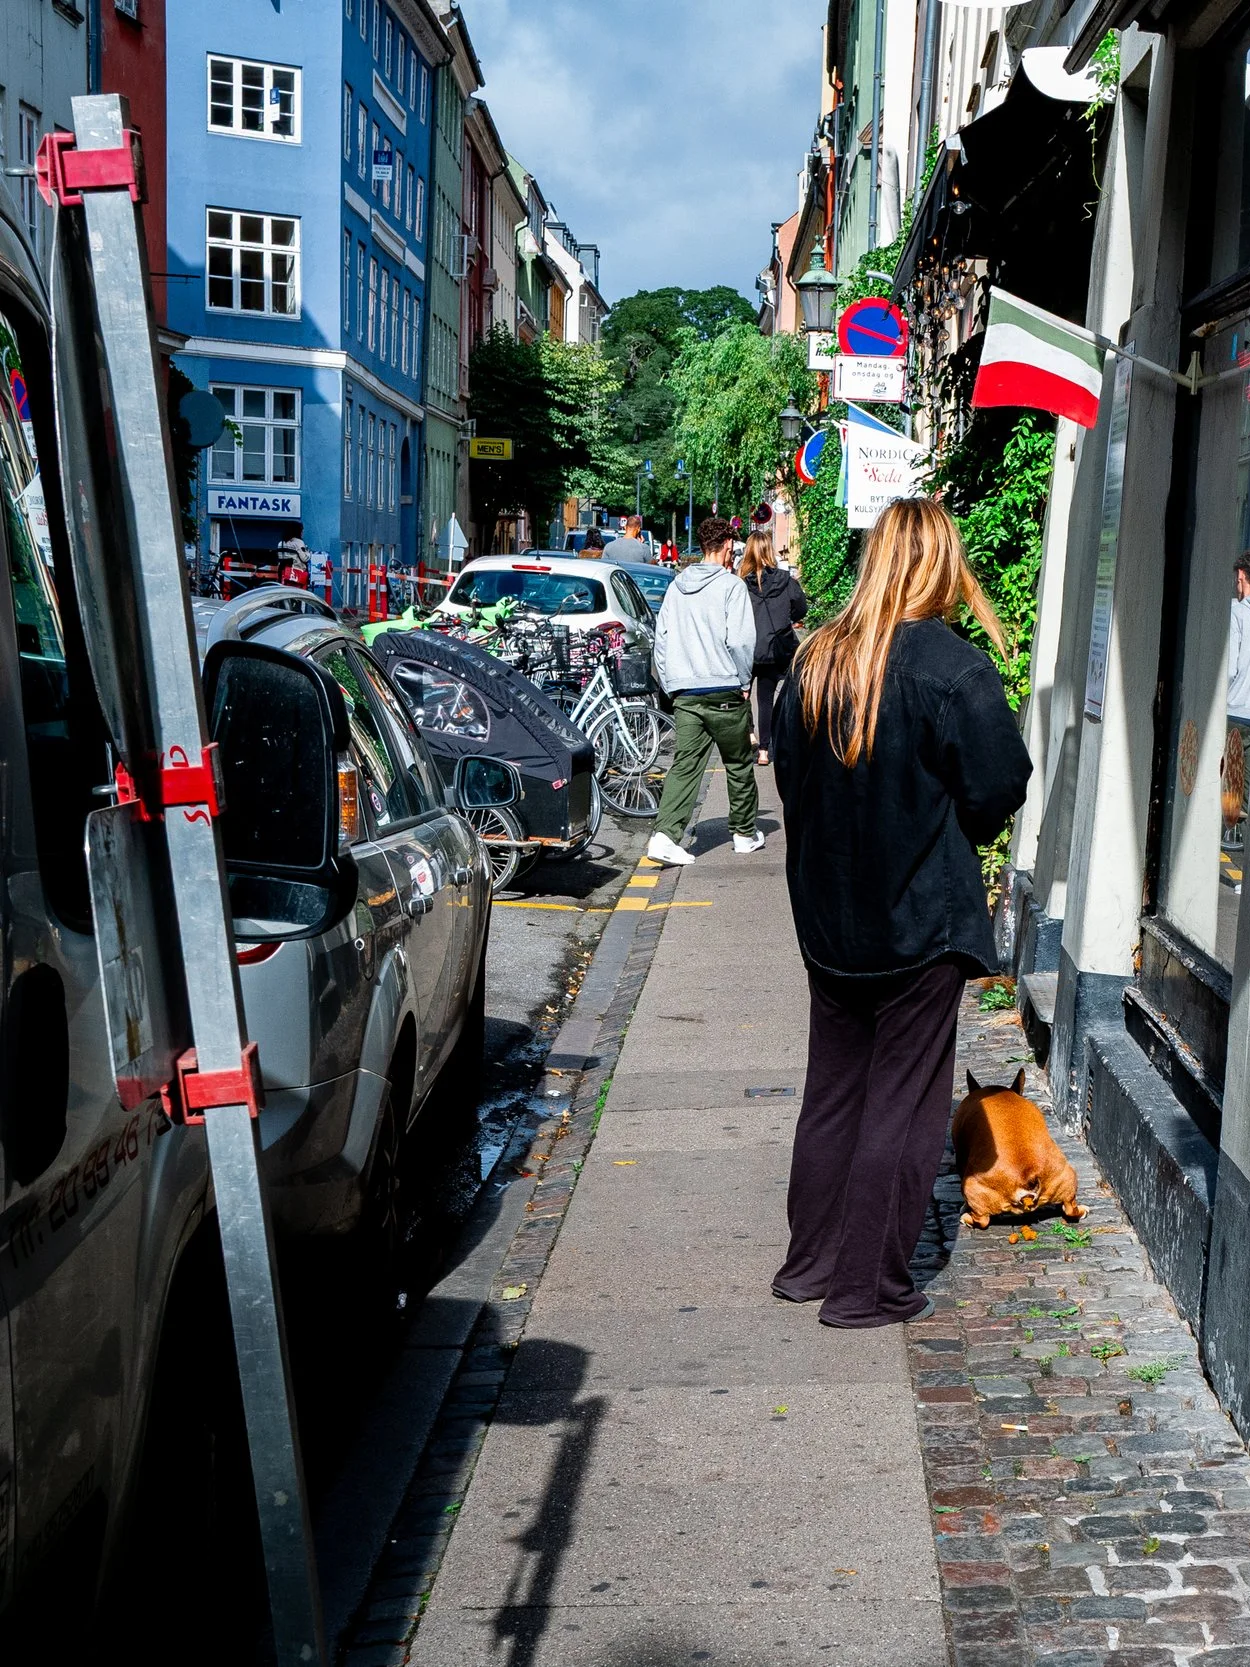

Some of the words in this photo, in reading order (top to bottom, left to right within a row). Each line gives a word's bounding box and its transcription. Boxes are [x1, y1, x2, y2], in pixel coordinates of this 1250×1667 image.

[851, 371, 881, 379] onsdag
[884, 372, 894, 380] og
[477, 445, 502, 454] MEN'S
[858, 447, 914, 461] NORDIC
[868, 467, 902, 483] Soda
[217, 495, 291, 512] FANTASK
[870, 495, 884, 503] BYT
[50, 1165, 79, 1233] 20
[83, 1135, 110, 1200] 99
[114, 1113, 140, 1166] 46
